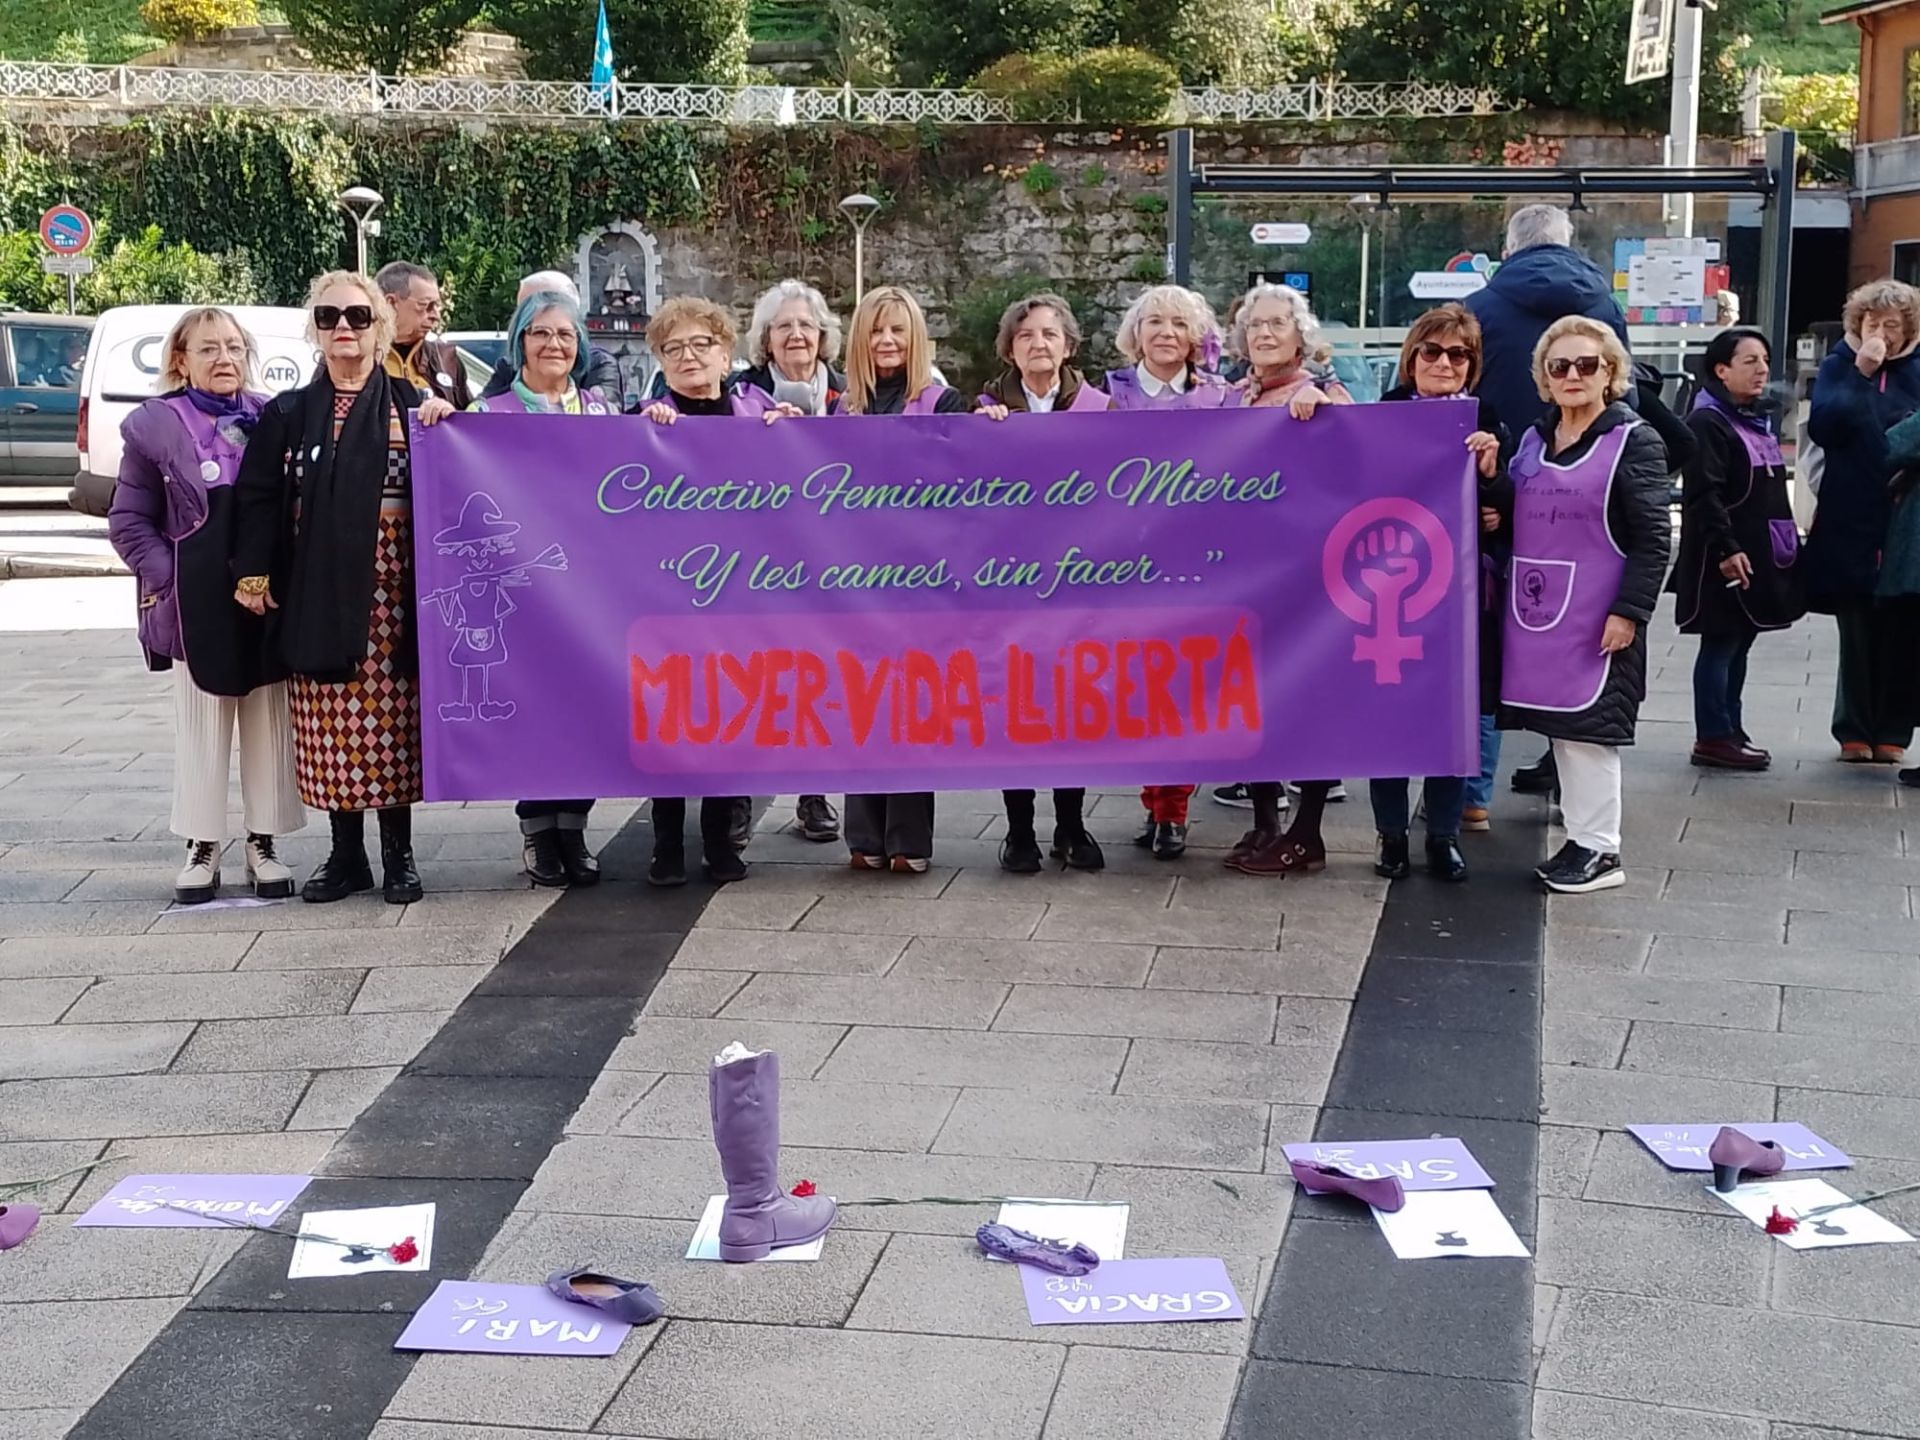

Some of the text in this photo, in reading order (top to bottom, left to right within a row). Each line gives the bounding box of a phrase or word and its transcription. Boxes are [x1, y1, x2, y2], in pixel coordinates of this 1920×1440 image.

[264, 366, 296, 381] ATR
[596, 457, 1286, 515] Colectivo Feminista de Mieres
[748, 554, 811, 590] les
[818, 556, 963, 592] cames,
[972, 556, 1043, 587] sin
